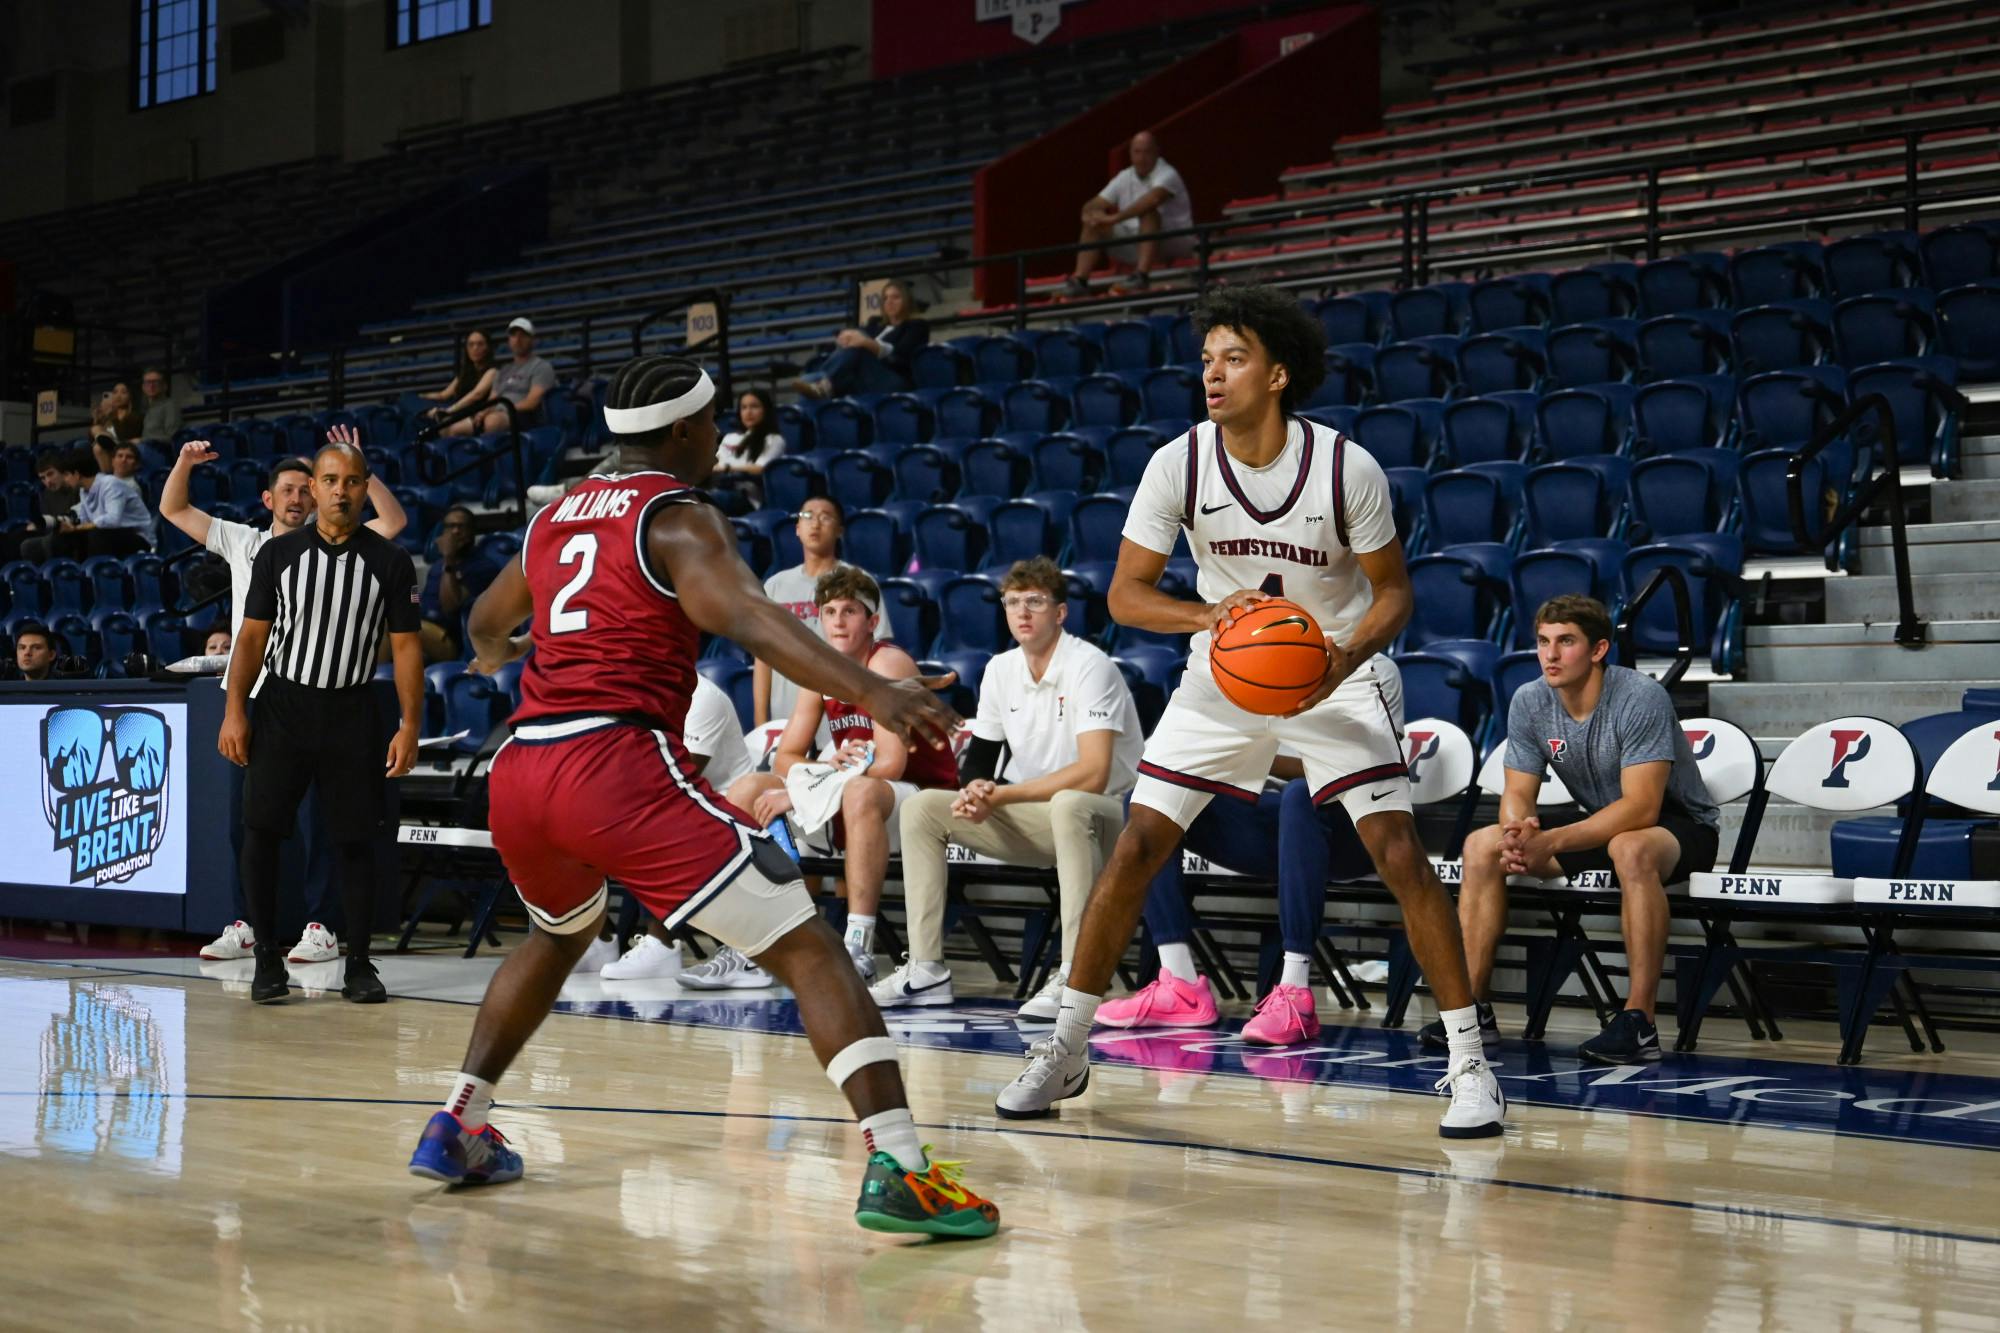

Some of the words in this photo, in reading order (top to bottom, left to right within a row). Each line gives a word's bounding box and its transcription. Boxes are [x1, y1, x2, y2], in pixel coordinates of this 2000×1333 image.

[692, 315, 714, 330] 103
[40, 400, 54, 415] 103
[1209, 537, 1329, 567] PENNSYLVANIA
[550, 533, 598, 634] 2
[1547, 738, 1567, 763] P
[1821, 729, 1872, 788] P
[59, 787, 112, 840] LIVE
[110, 795, 140, 822] LIKE
[76, 810, 154, 873] BRENT
[409, 829, 438, 842] PENN
[947, 847, 977, 861] ENN
[96, 852, 150, 884] FOUNDATION
[1436, 864, 1463, 880] EN
[1720, 877, 1782, 896] PENN
[1888, 883, 1955, 901] PENN
